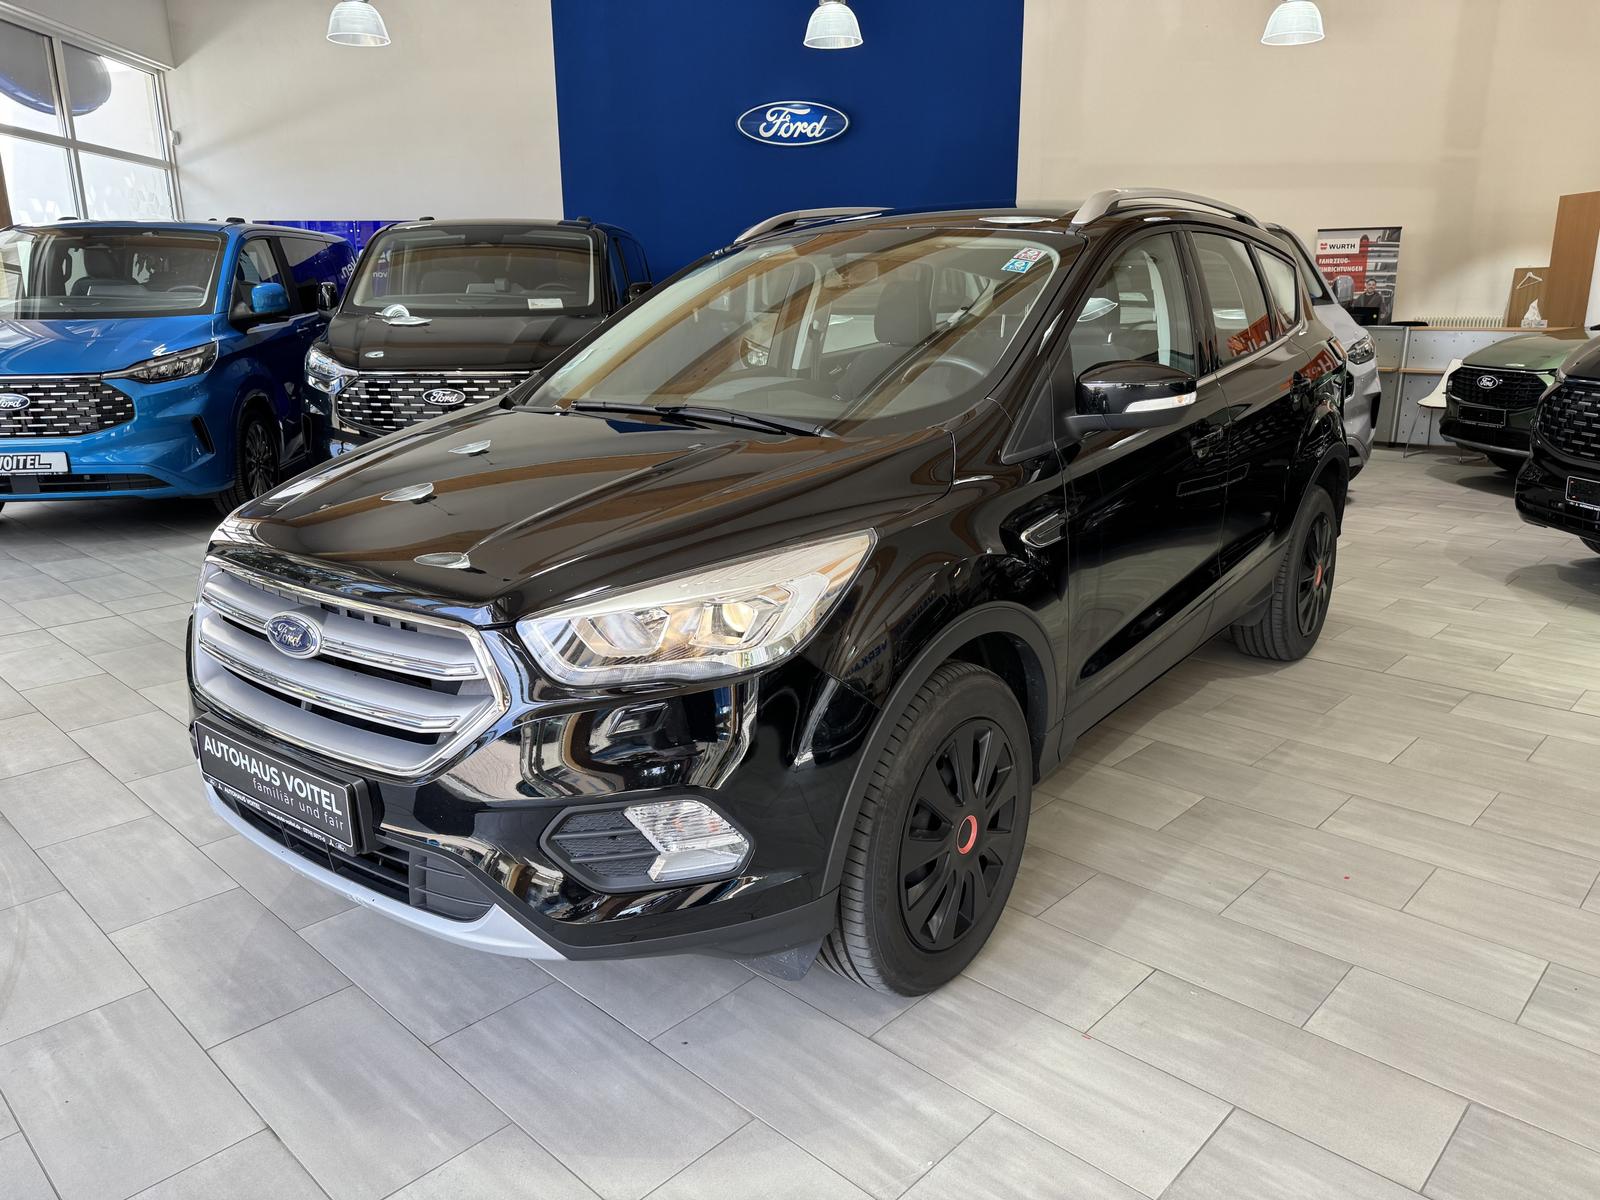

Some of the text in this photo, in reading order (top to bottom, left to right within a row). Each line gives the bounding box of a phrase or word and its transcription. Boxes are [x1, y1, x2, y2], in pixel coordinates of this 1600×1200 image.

[759, 106, 828, 138] Ford
[430, 390, 458, 403] Ford
[269, 623, 303, 648] Ford
[204, 735, 343, 815] AUTOHAUS VOITEL
[252, 777, 344, 831] familiär und fair
